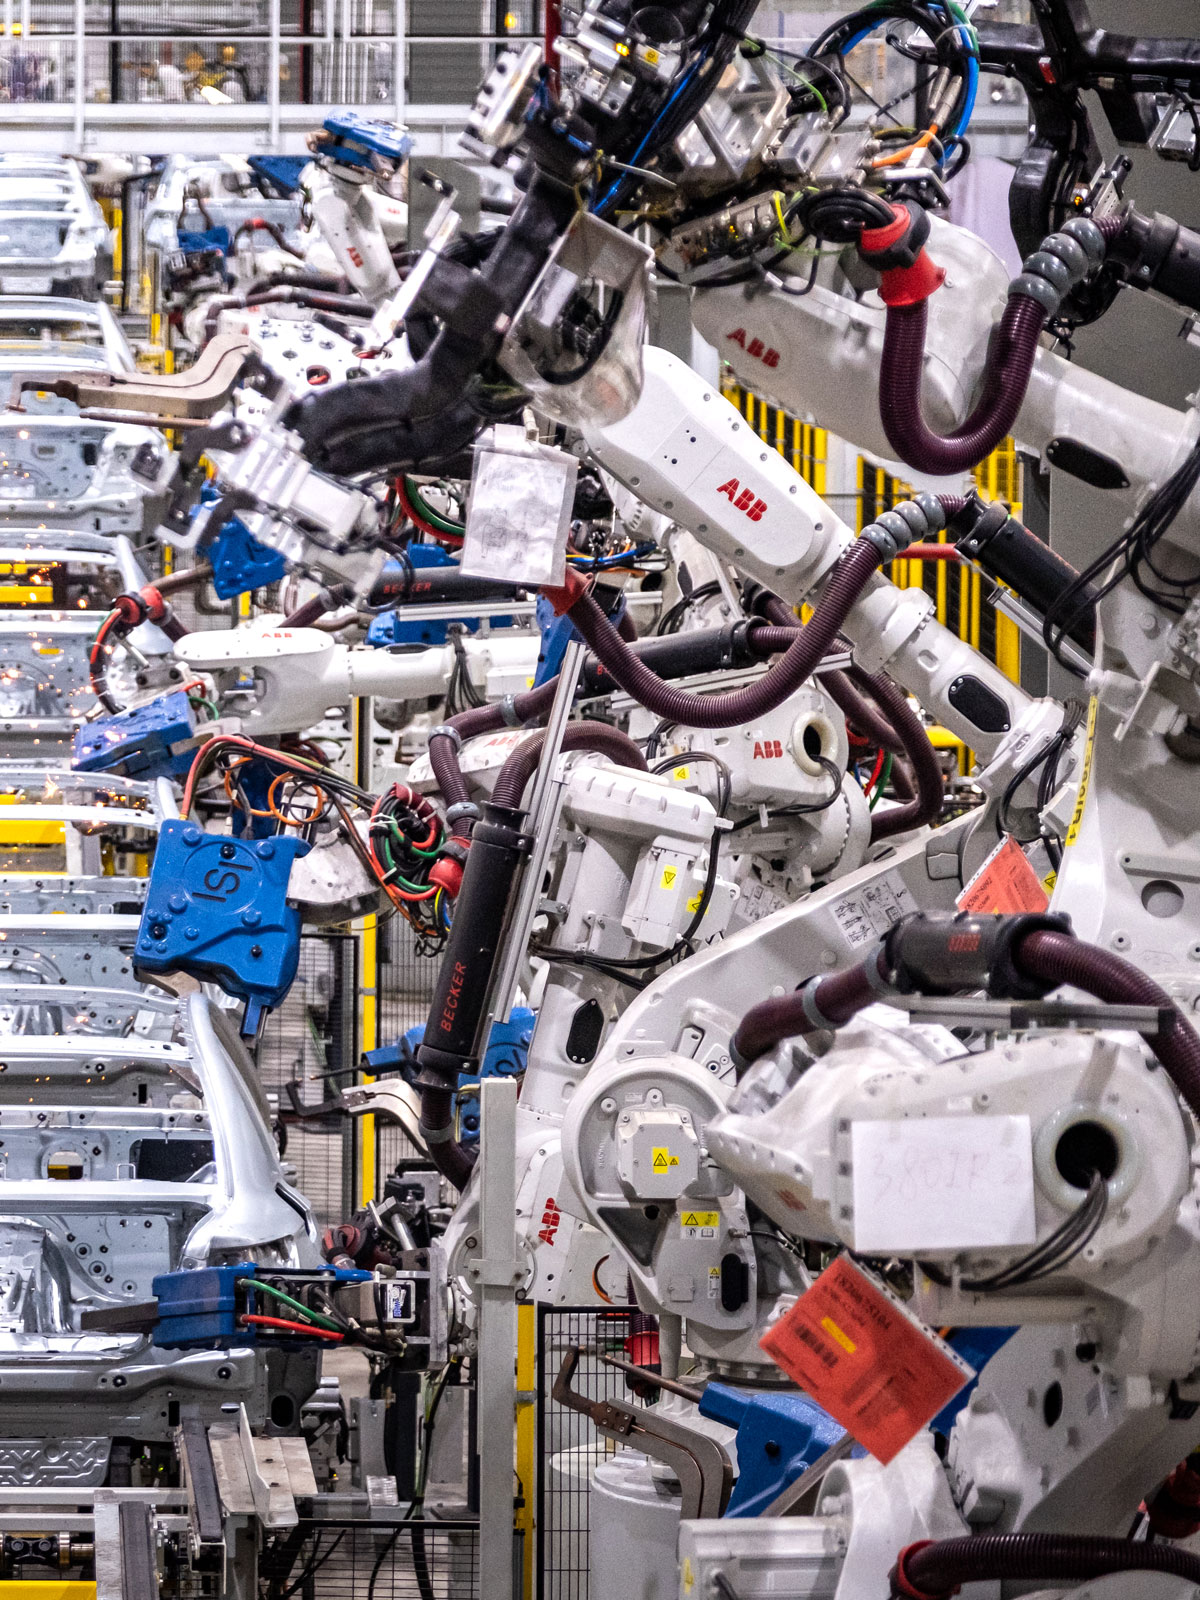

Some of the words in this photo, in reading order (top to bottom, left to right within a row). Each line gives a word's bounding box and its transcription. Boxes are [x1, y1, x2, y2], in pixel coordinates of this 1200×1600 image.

[726, 327, 780, 369] ABB
[716, 477, 768, 523] ABB
[752, 739, 784, 760] ABB
[440, 961, 467, 1033] BECKER
